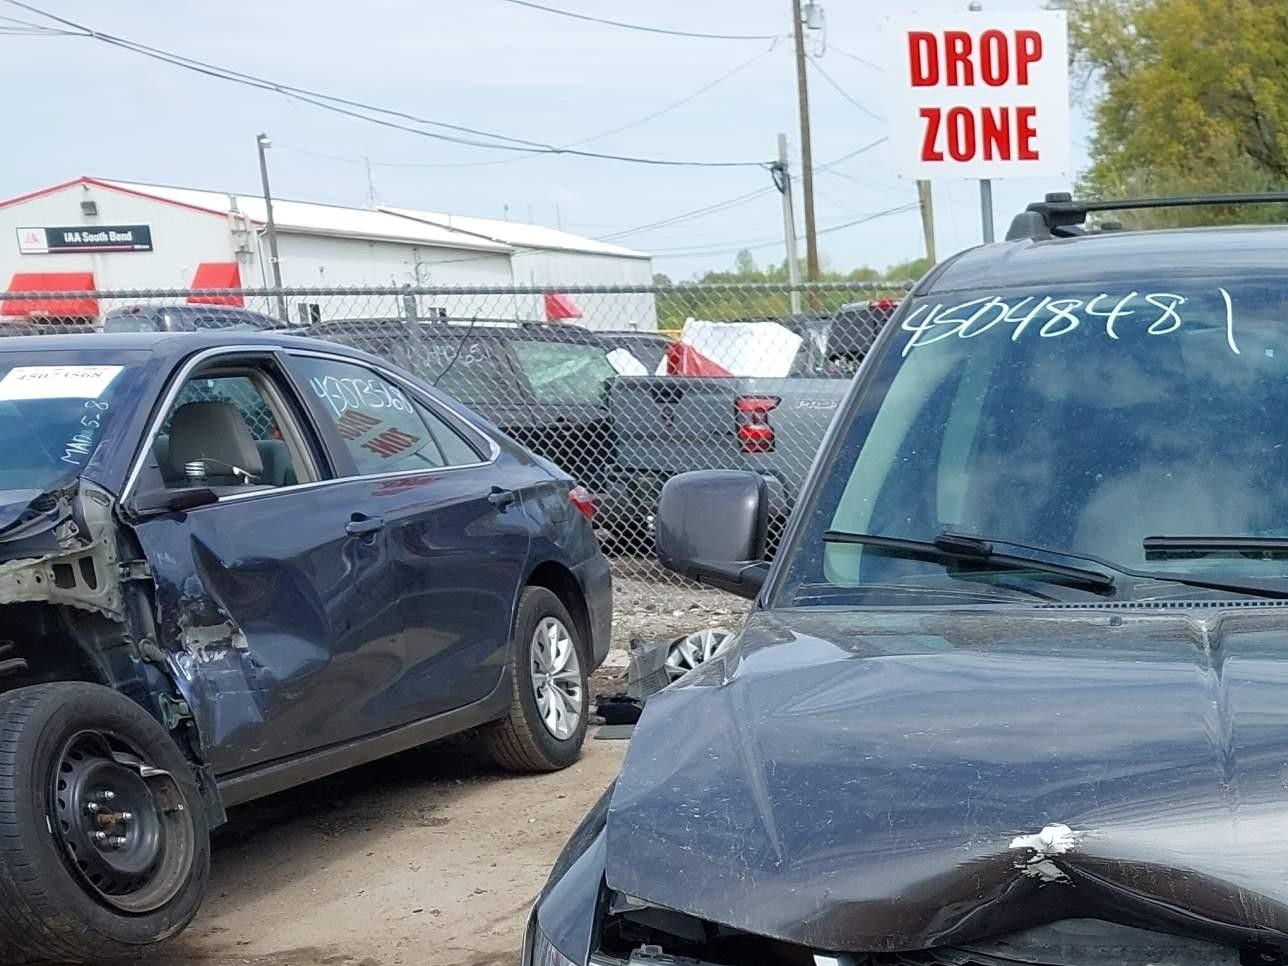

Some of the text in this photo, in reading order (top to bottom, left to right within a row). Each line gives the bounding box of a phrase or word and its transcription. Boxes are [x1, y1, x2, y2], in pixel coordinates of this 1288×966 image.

[908, 29, 1043, 87] DROP
[918, 105, 1040, 162] ZONE
[64, 230, 133, 243] IAA South Bend
